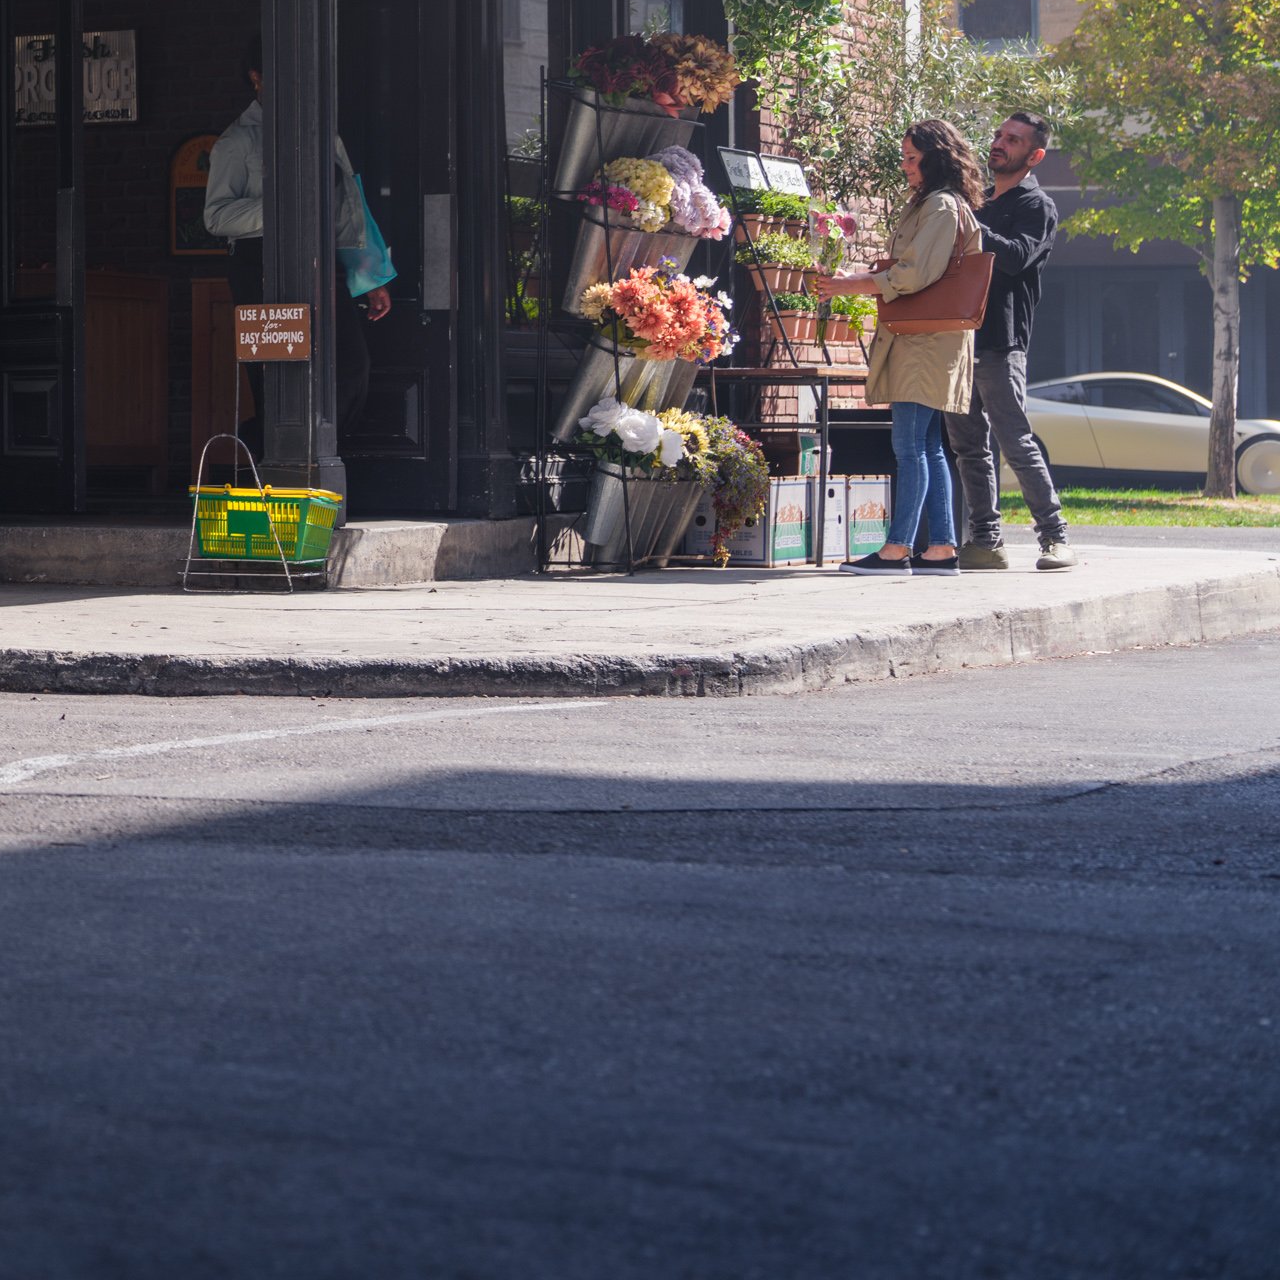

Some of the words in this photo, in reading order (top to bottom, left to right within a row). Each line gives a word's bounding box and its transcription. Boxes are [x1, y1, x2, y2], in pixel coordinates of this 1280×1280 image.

[239, 309, 257, 321] USE
[259, 310, 267, 320] A
[269, 308, 304, 320] BASKET
[240, 332, 260, 345] EASY
[261, 331, 304, 344] SHOPPING
